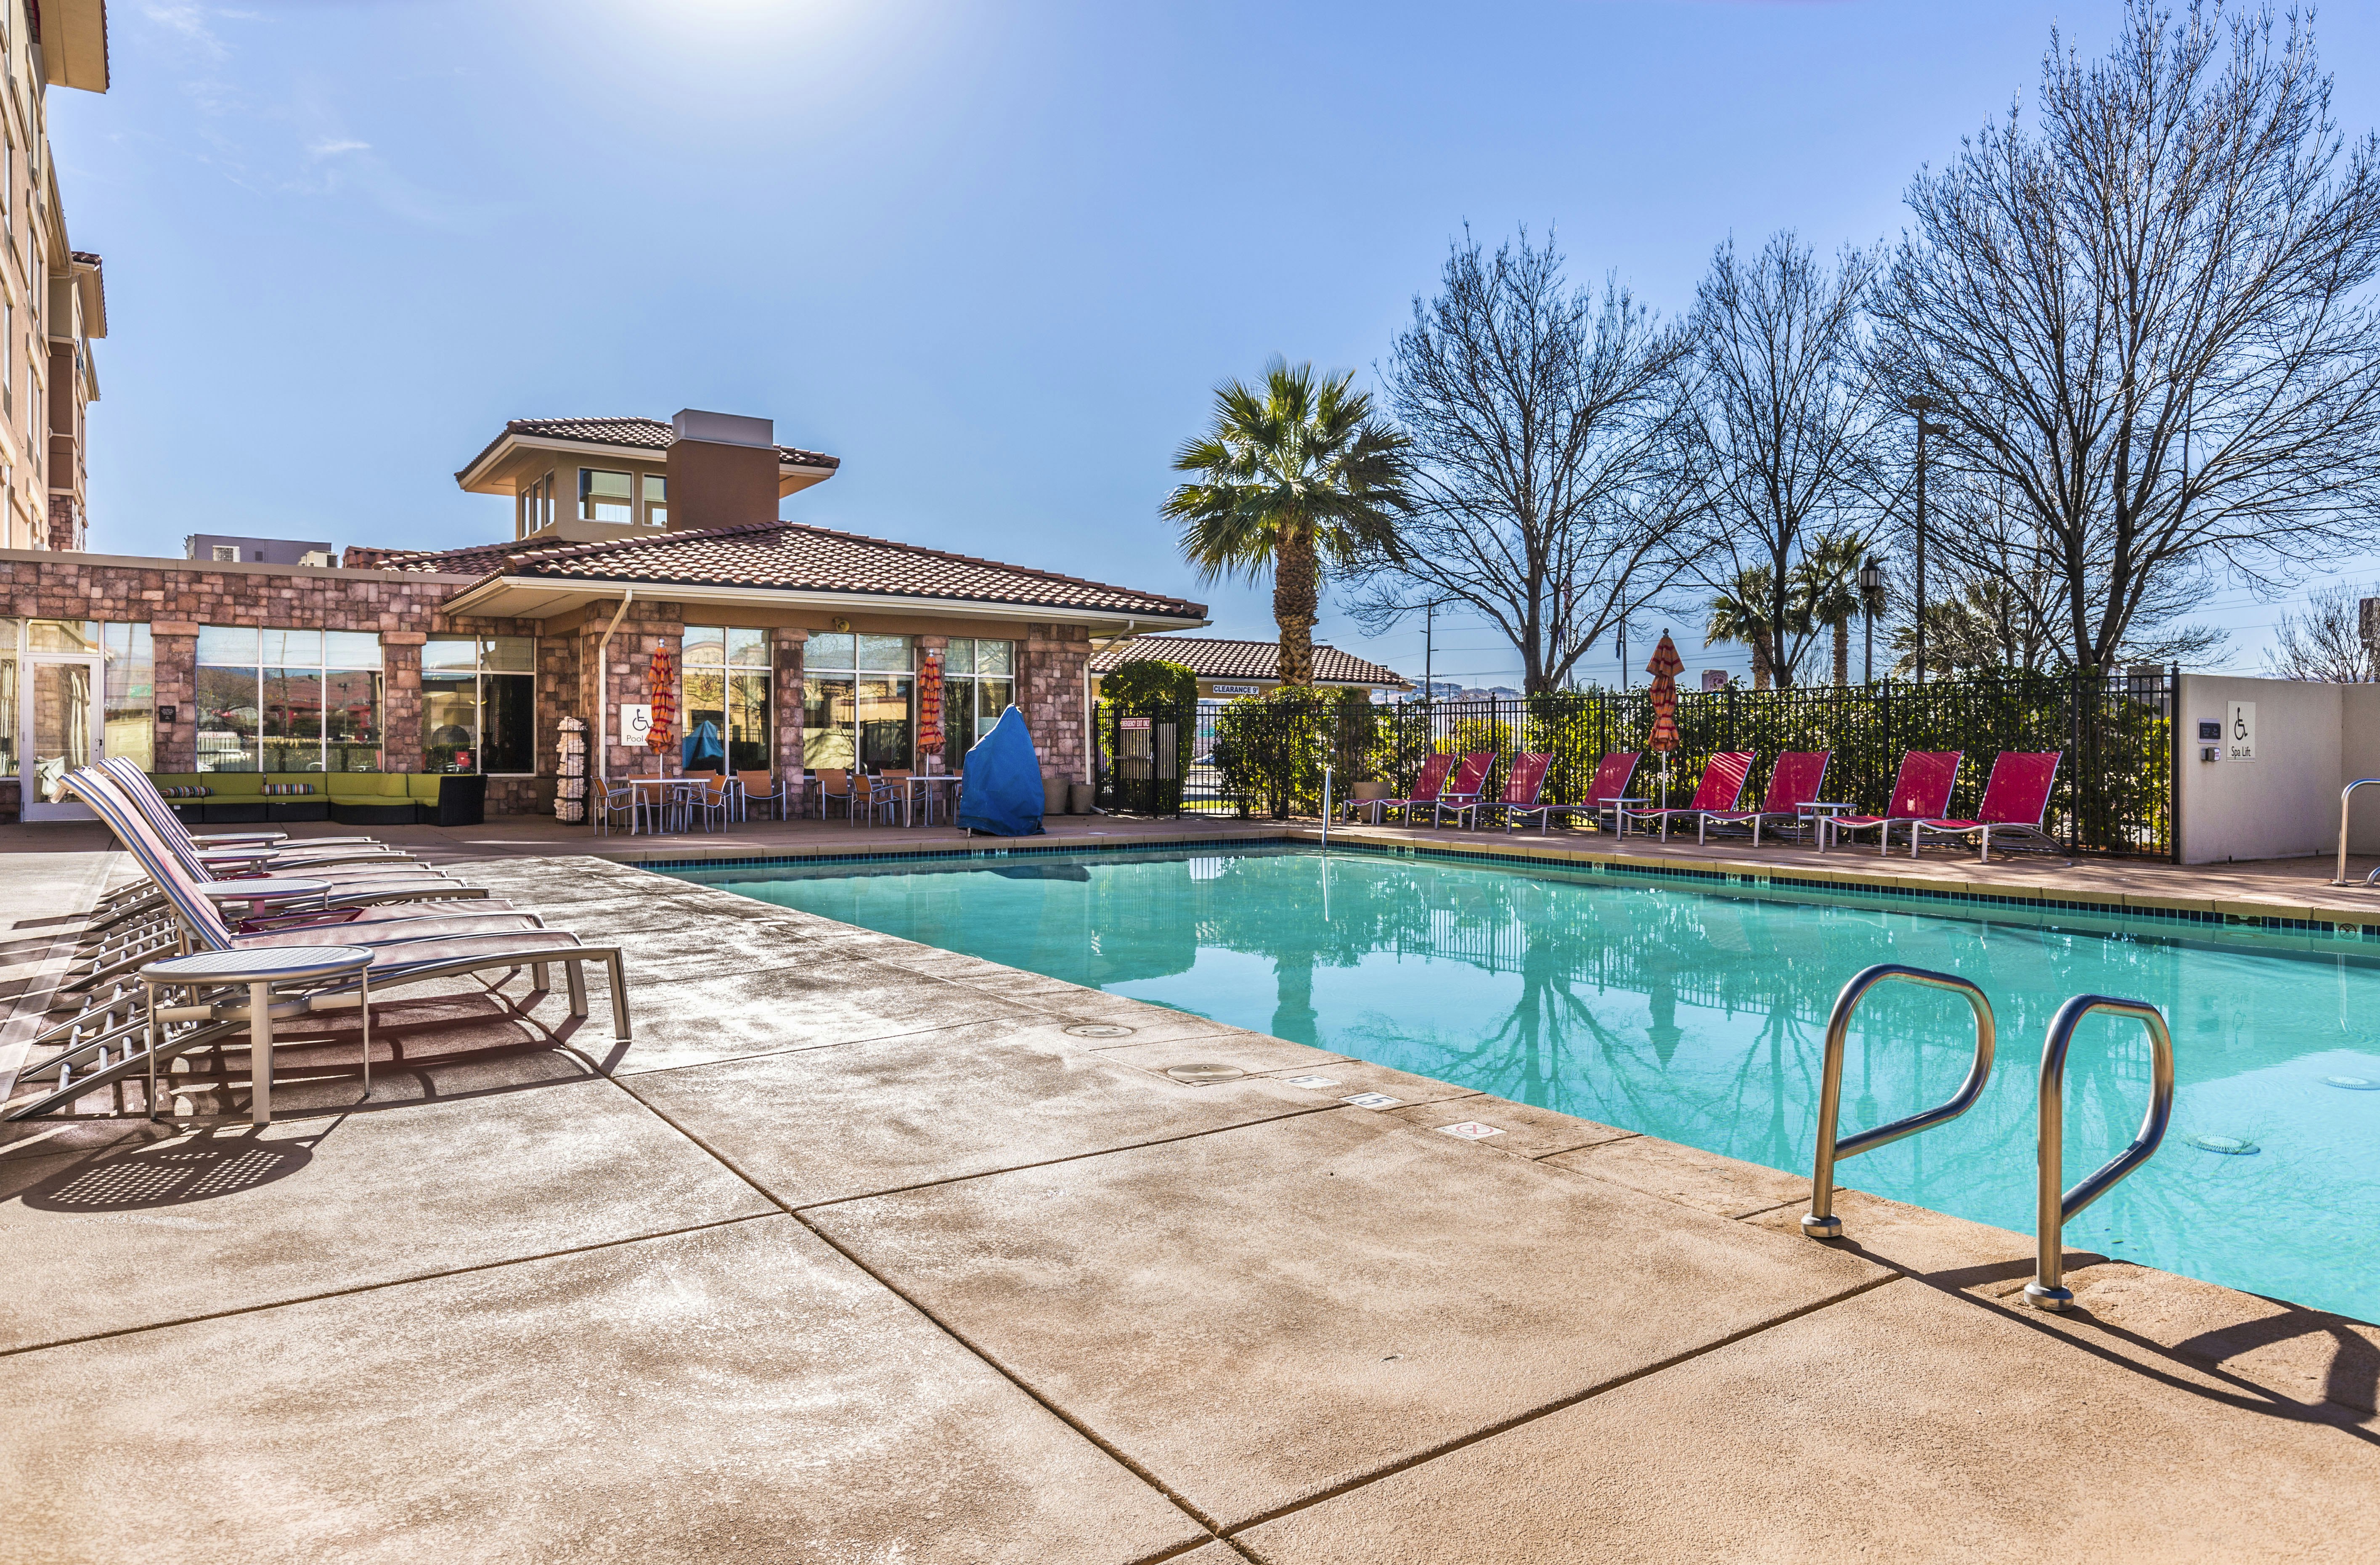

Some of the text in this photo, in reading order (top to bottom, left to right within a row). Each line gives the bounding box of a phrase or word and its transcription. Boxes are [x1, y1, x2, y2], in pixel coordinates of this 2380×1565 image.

[2232, 746, 2240, 760] Spa
[2242, 746, 2251, 756] Lift
[1344, 1093, 1394, 1105] 1.5
